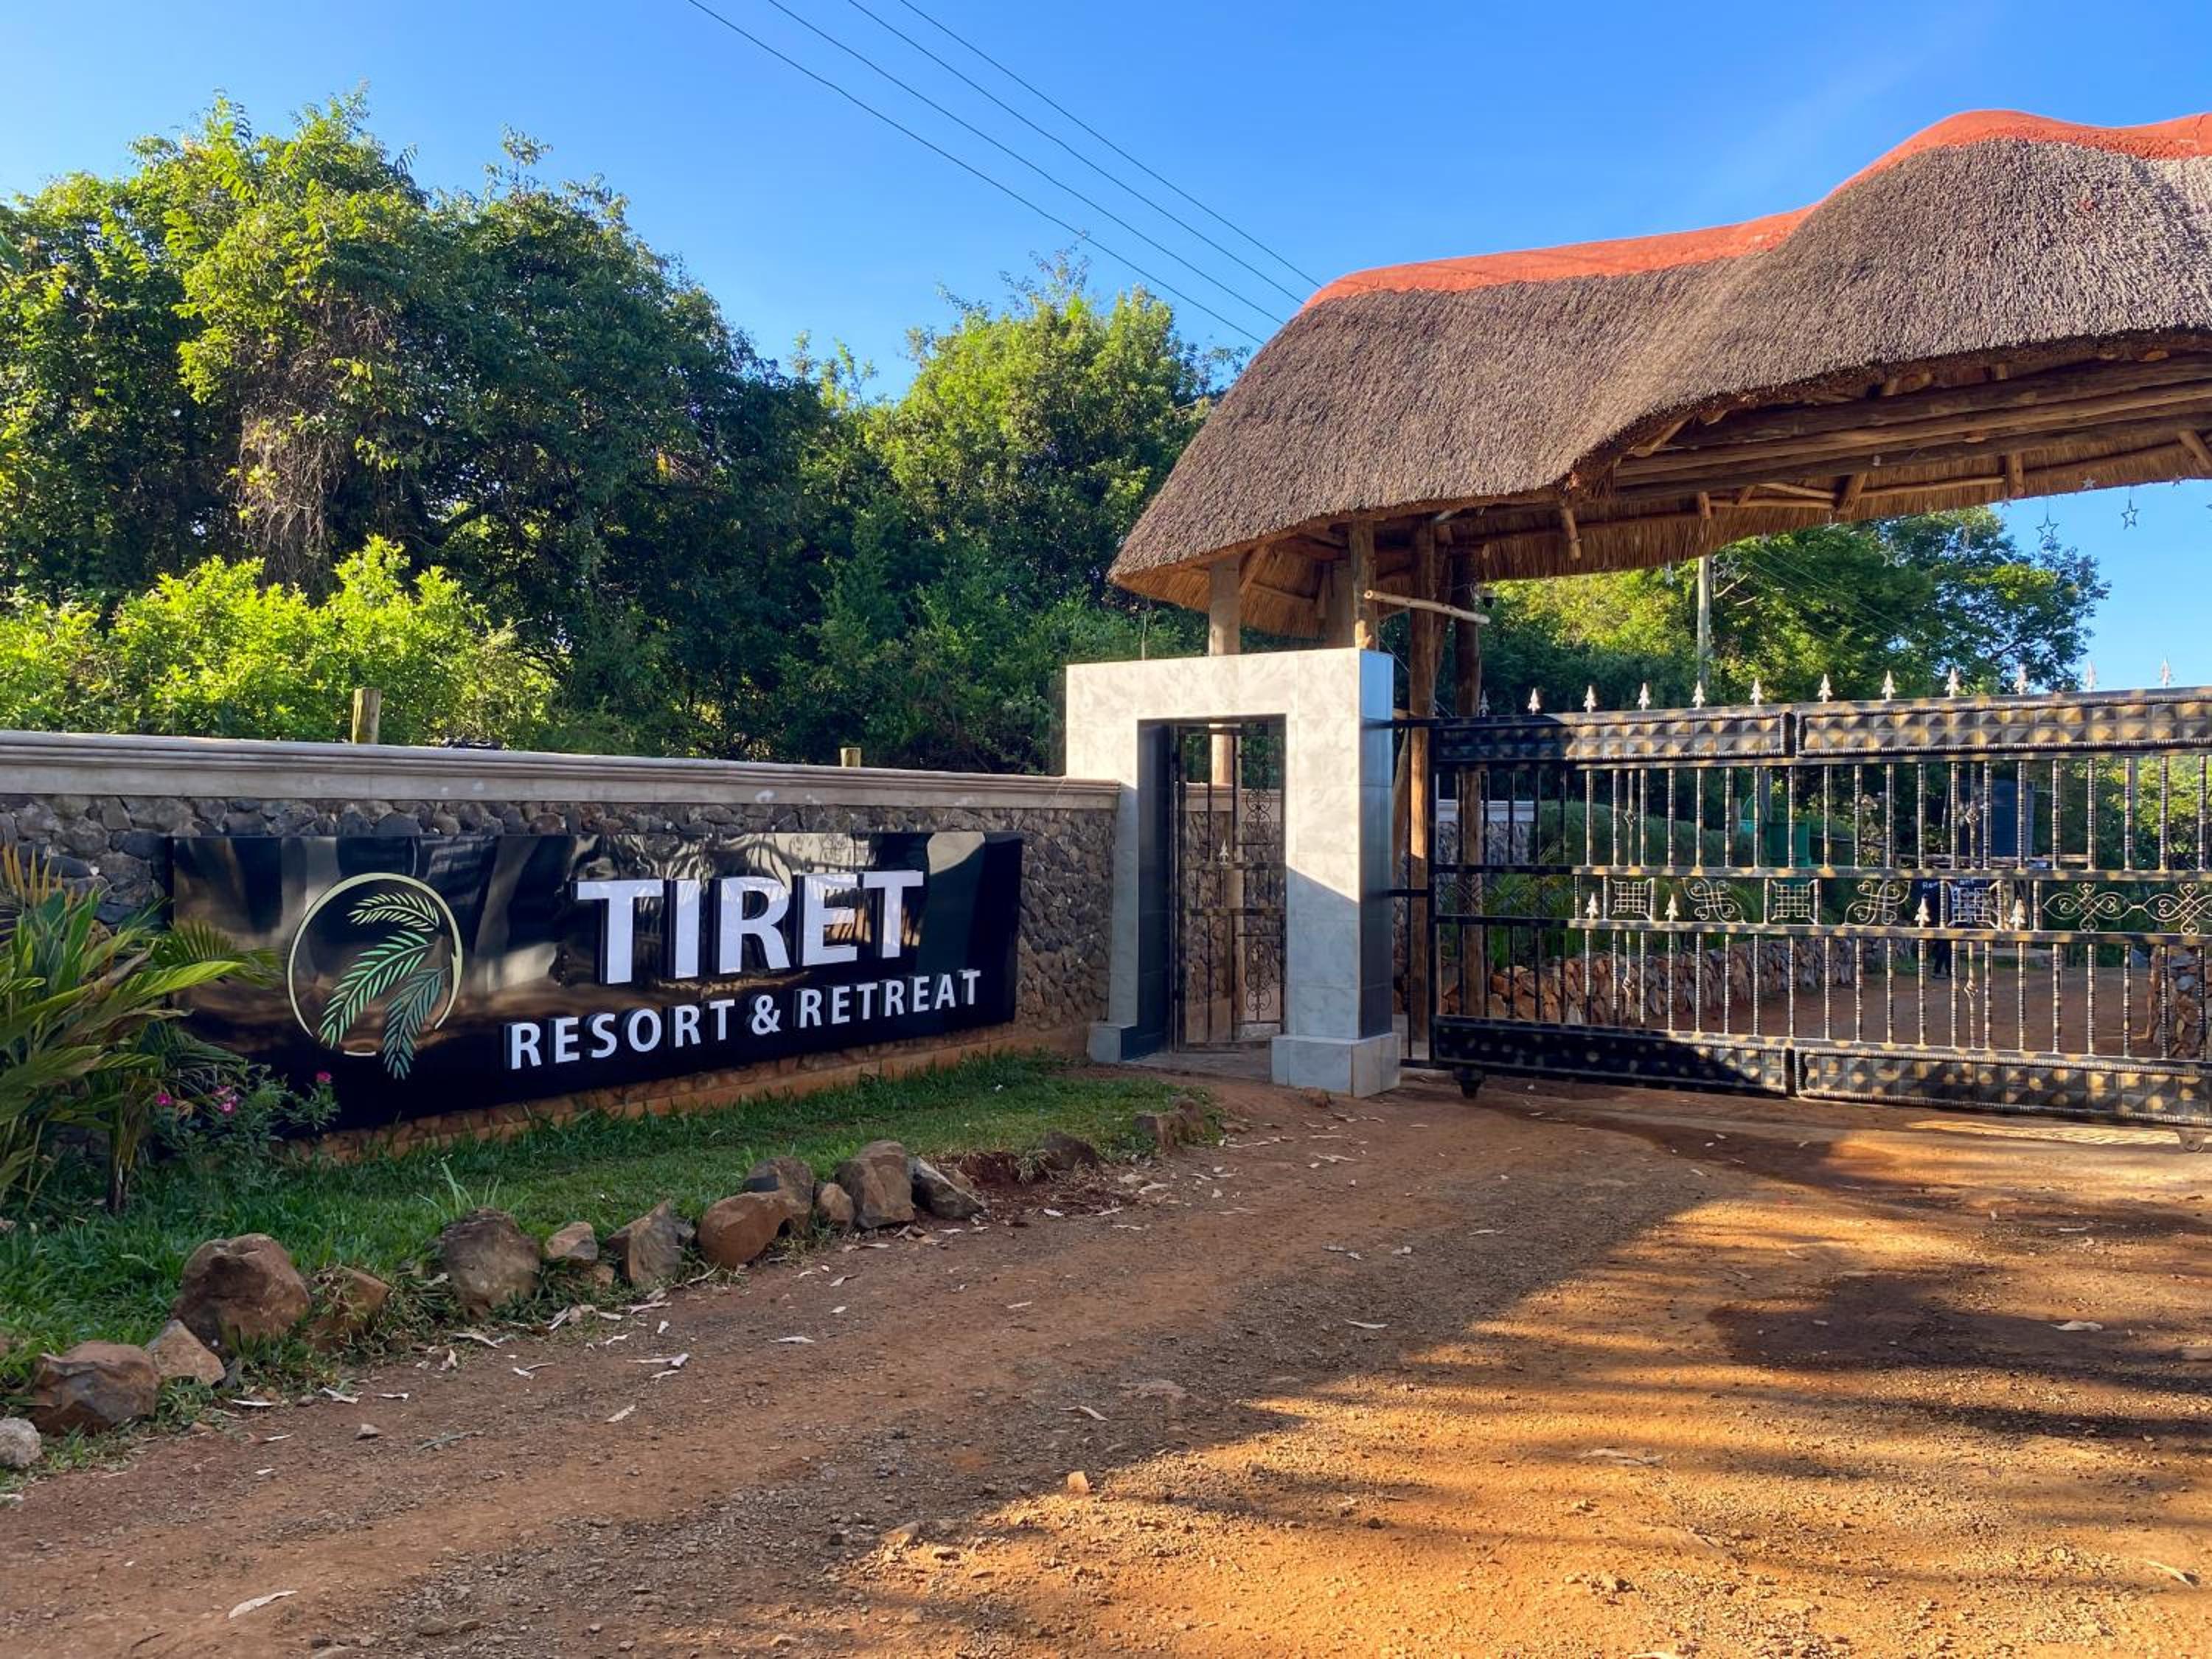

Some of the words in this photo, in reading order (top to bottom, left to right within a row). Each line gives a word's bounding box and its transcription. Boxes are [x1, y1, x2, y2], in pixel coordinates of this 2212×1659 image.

[577, 869, 924, 984] TIRET
[510, 998, 735, 1070] RESORT
[751, 995, 781, 1035] &
[799, 970, 981, 1028] RETREAT
